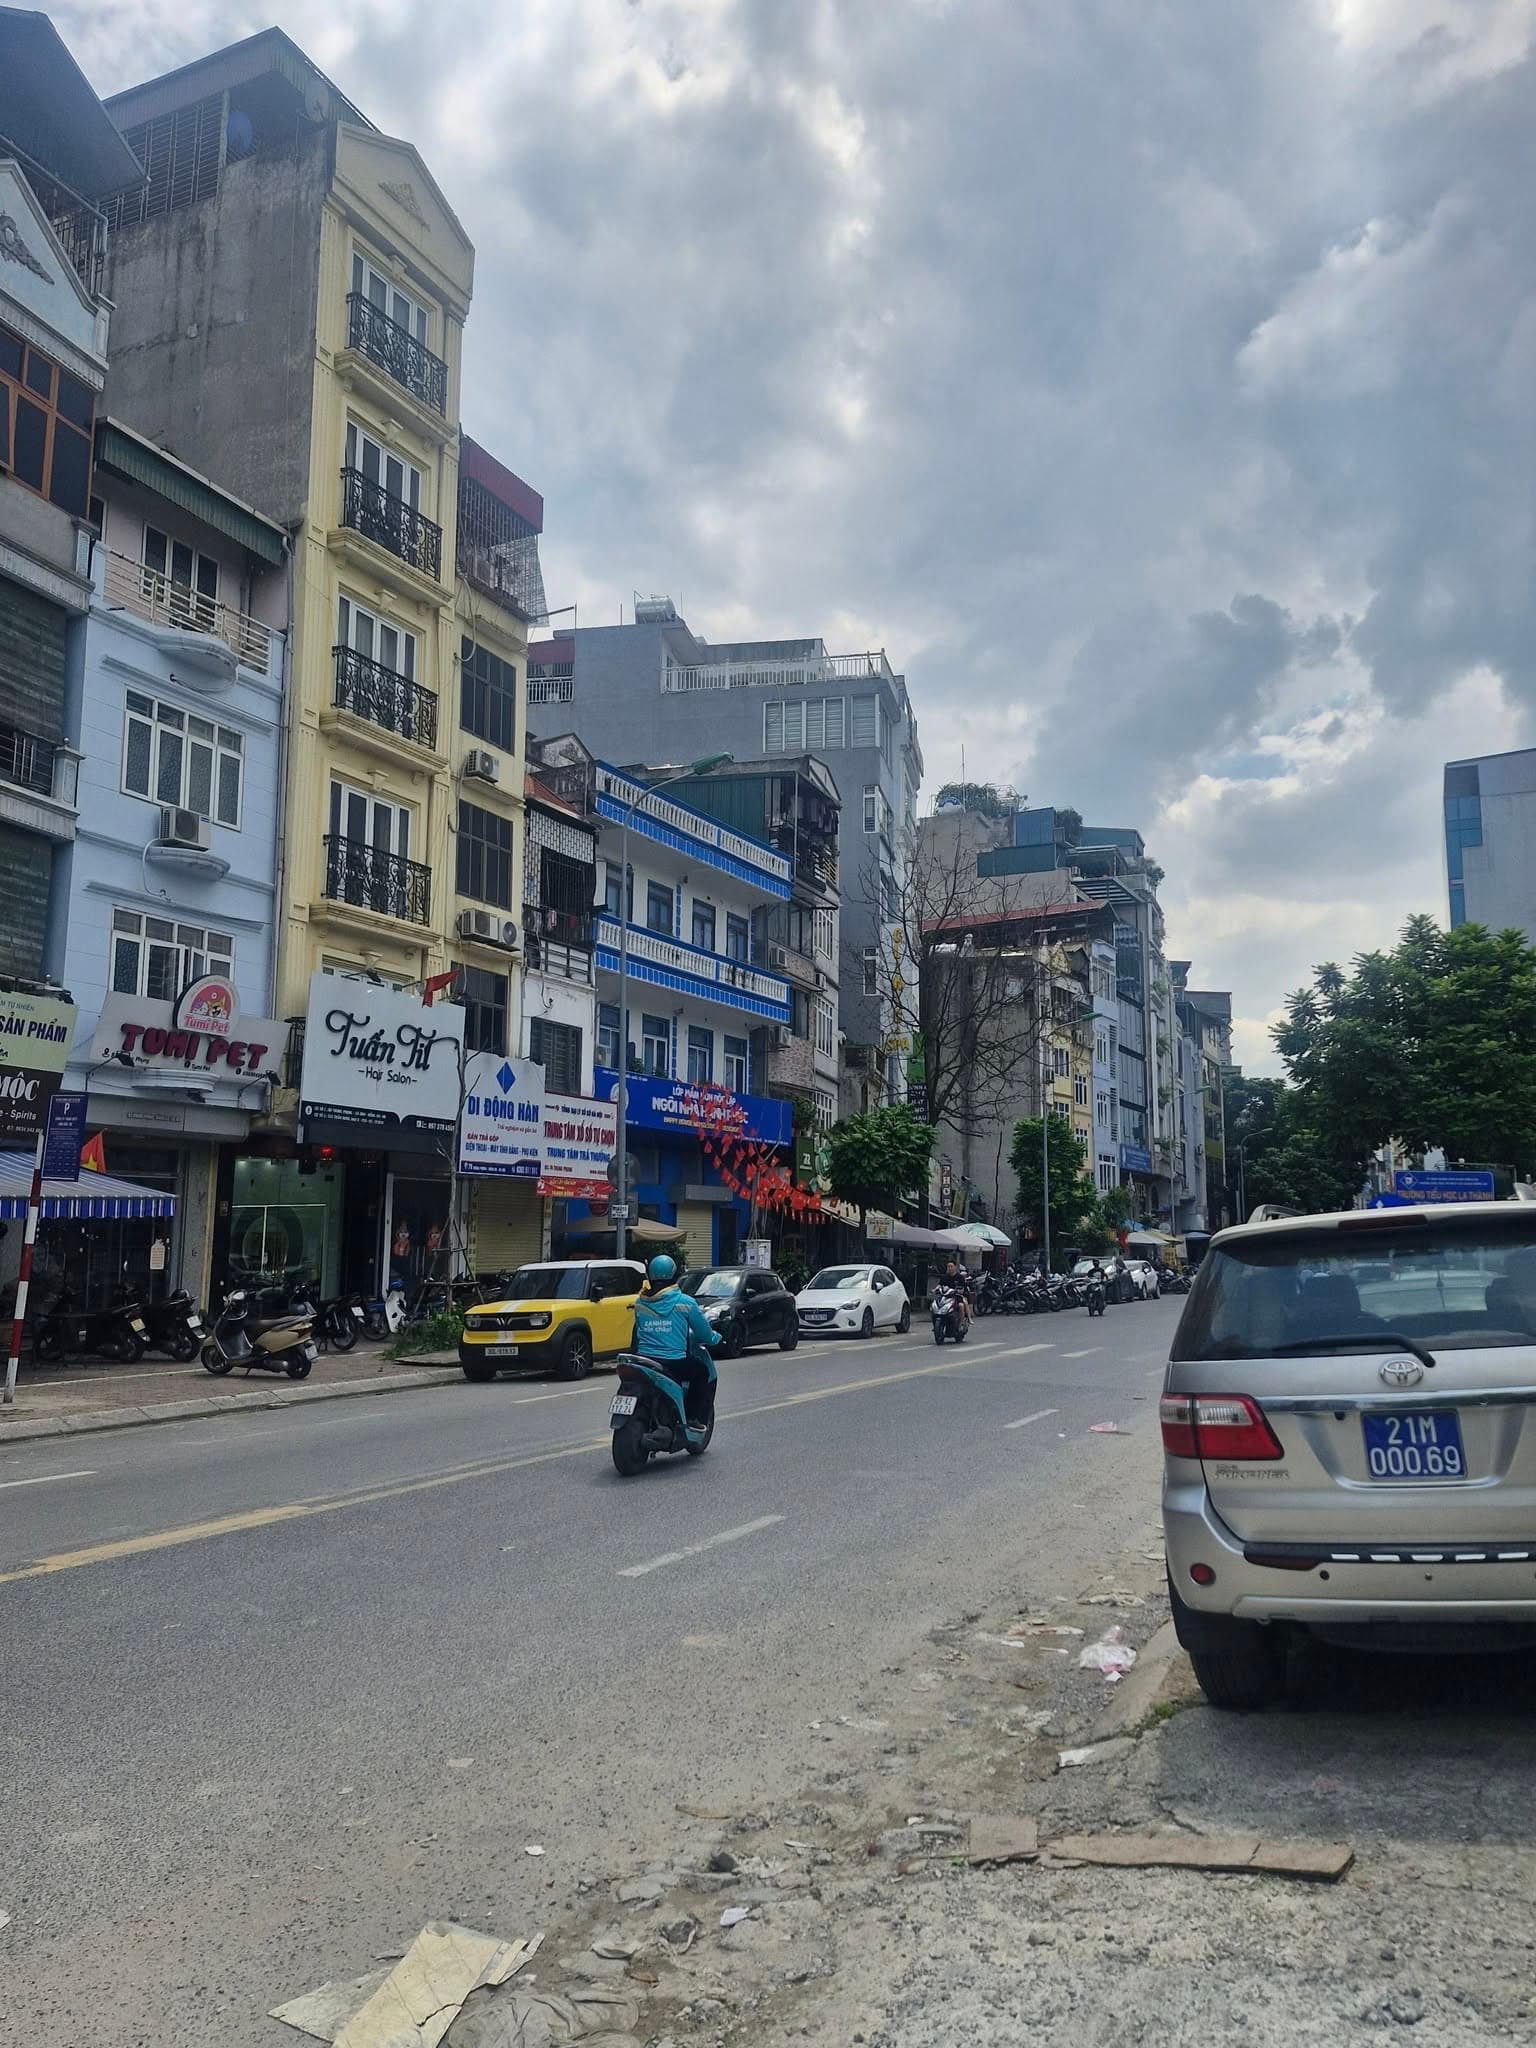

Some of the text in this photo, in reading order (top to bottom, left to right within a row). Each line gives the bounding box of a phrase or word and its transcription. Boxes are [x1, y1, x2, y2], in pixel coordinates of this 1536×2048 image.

[27, 1018, 68, 1043] PHẨM
[184, 1014, 230, 1034] Tumi Pet
[120, 1023, 269, 1069] TUMI PET
[325, 1009, 396, 1065] Tuấn
[672, 1084, 684, 1097] LỚP
[10, 1109, 37, 1120] Spirits
[64, 1102, 71, 1115] P
[468, 1095, 539, 1123] DI ĐỘNG HÀN
[652, 1096, 678, 1114] NGÔI
[544, 1120, 563, 1139] TRUNG
[563, 1120, 576, 1141] TÂM
[577, 1120, 585, 1142] XỔ
[585, 1121, 593, 1144] SỐ
[601, 1127, 615, 1147] CHỌN
[547, 1147, 566, 1159] TRUNG
[566, 1147, 579, 1160] TÂM
[1385, 1415, 1437, 1445] 21M
[1370, 1445, 1461, 1475] 000.69
